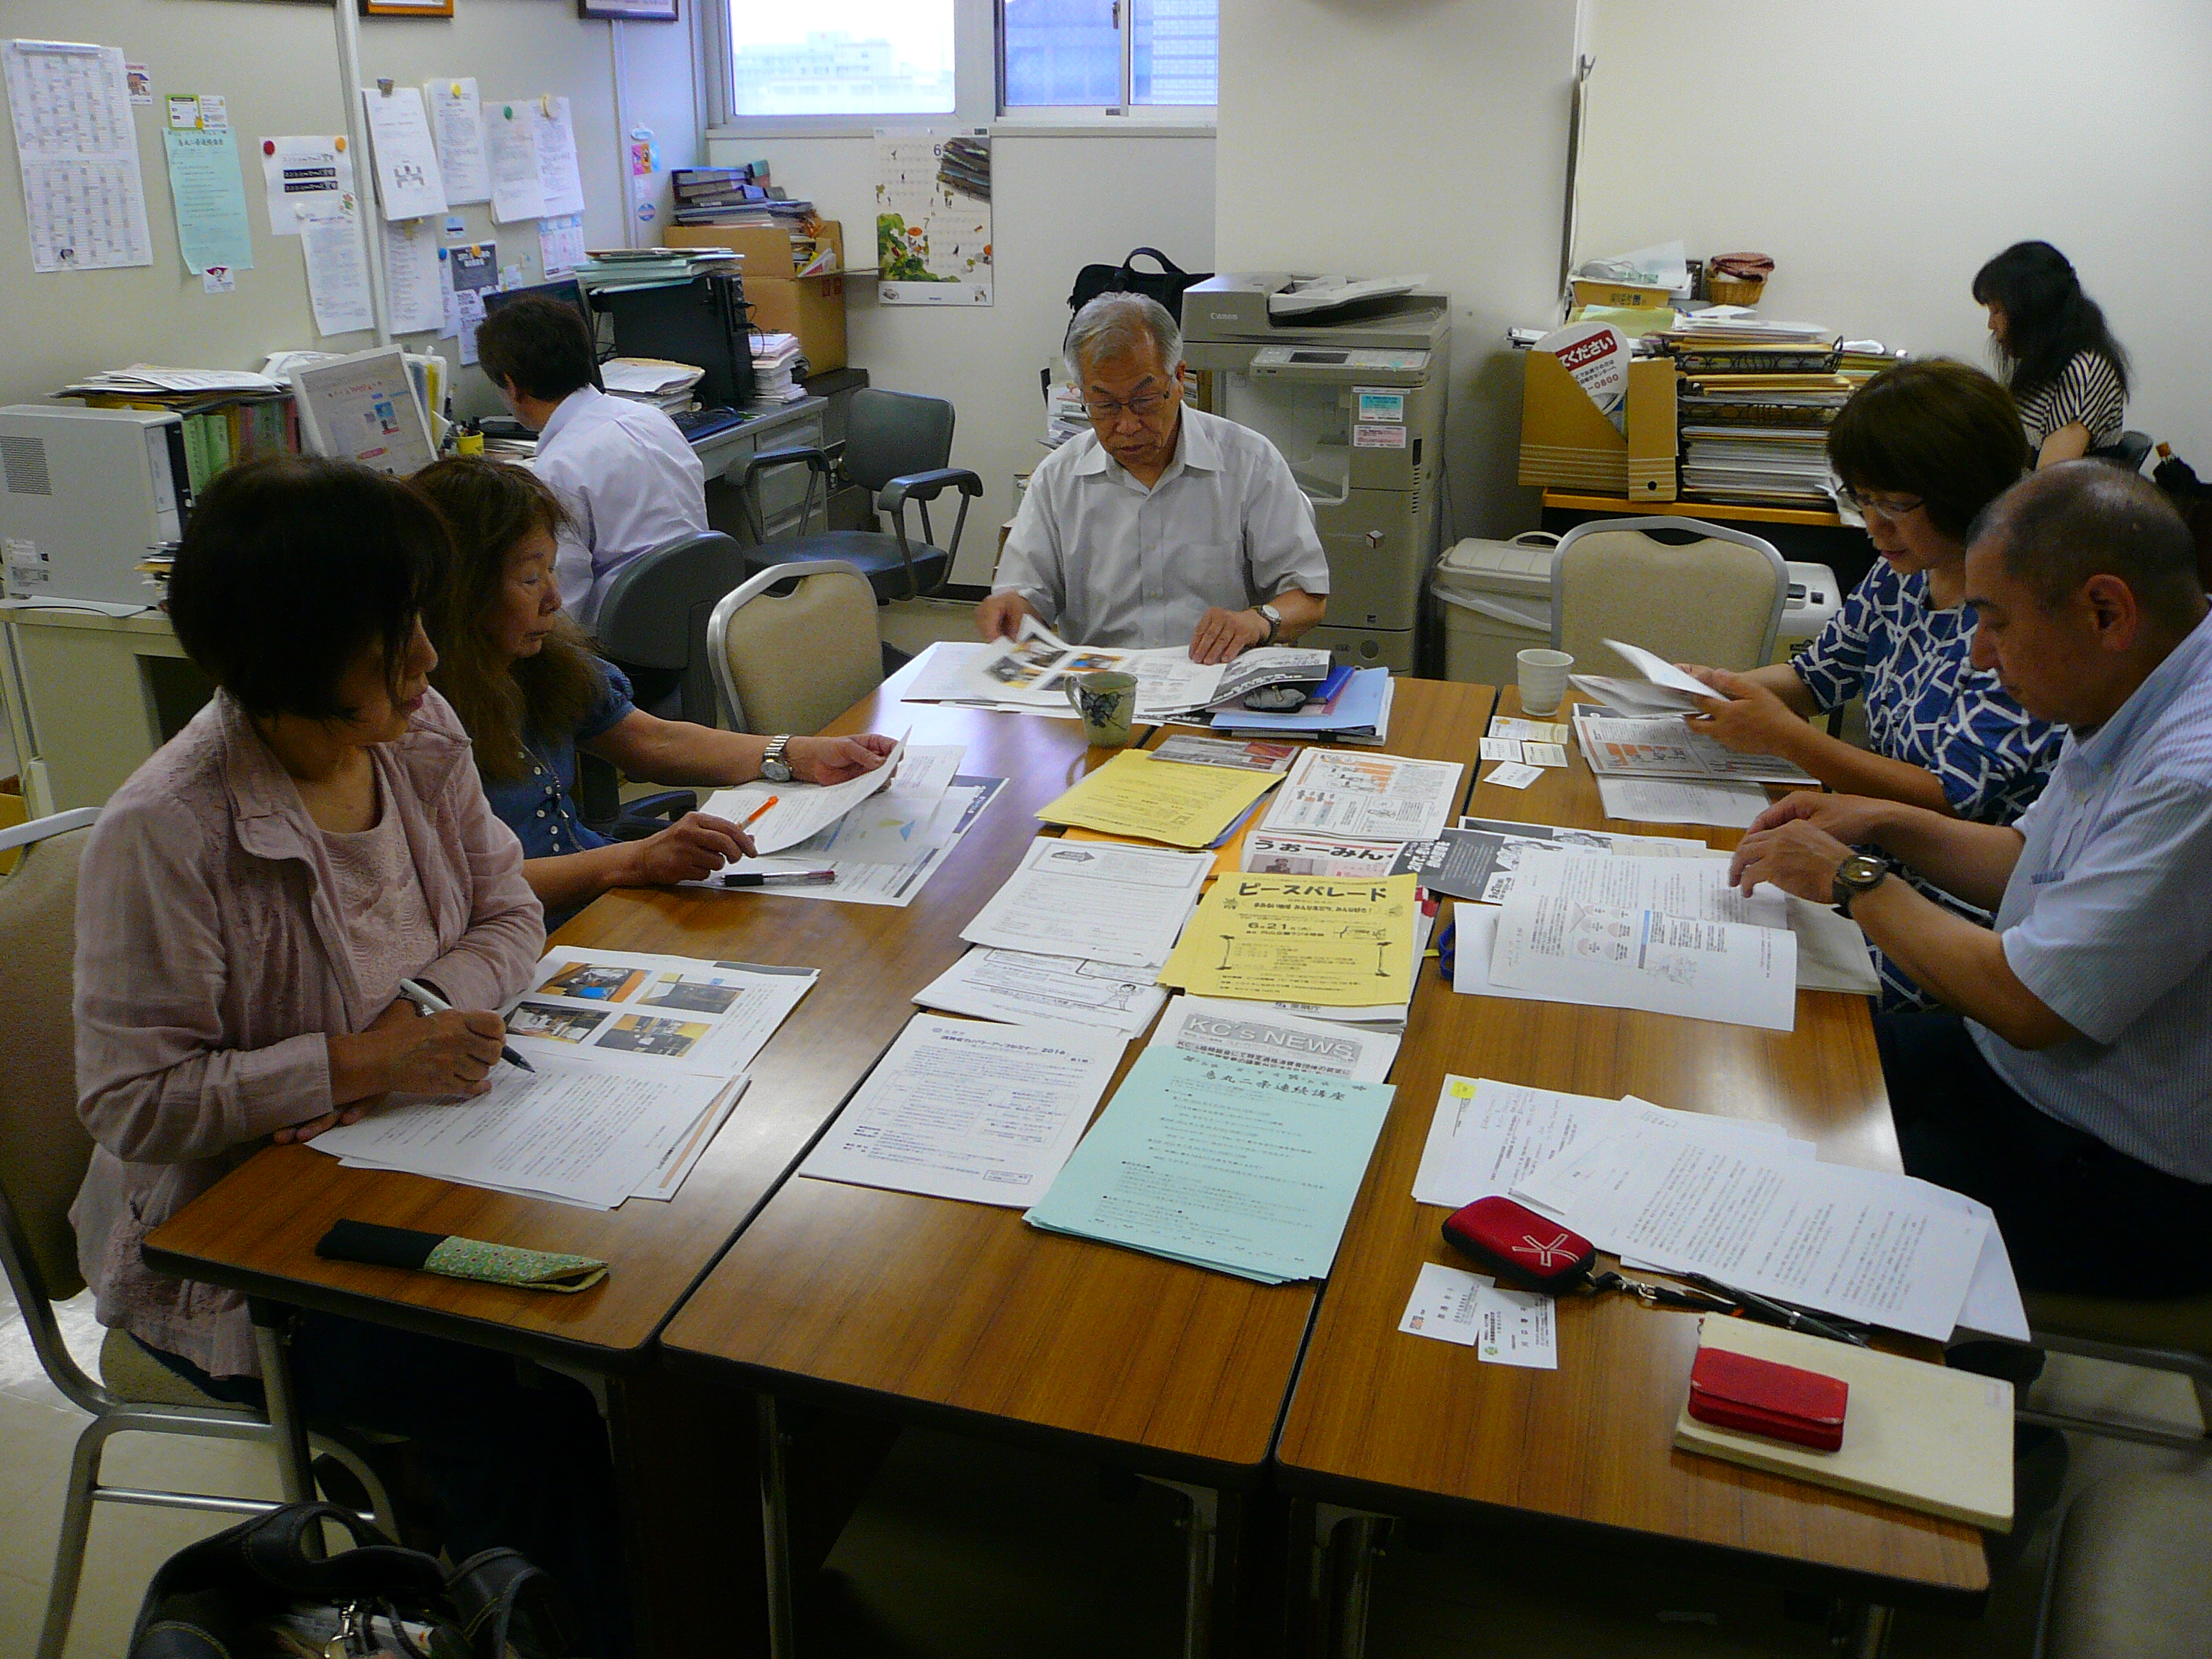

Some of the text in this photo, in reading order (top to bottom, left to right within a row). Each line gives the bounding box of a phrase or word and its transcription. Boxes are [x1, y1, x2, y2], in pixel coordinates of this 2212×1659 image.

[933, 144, 942, 156] 6
[923, 217, 930, 229] 7
[1238, 882, 1388, 902] ピースパレード
[1264, 1030, 1355, 1061] NEWS
